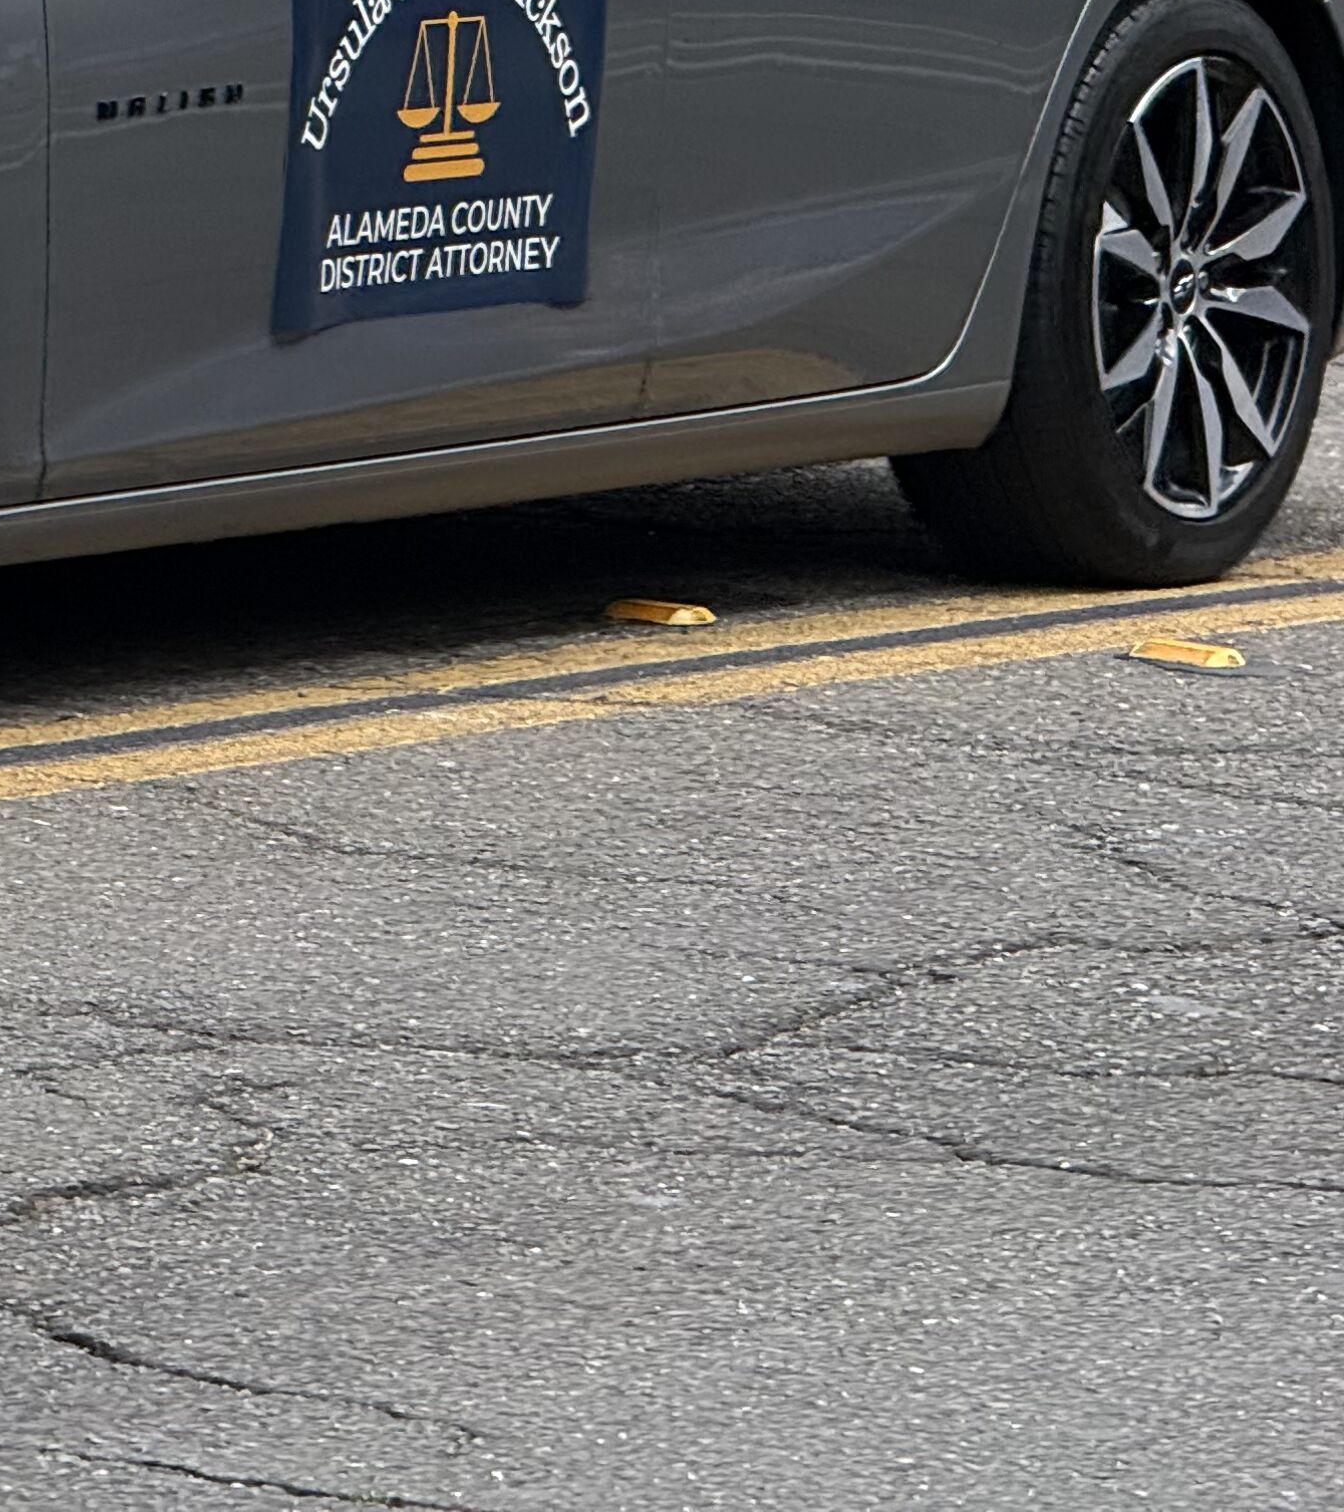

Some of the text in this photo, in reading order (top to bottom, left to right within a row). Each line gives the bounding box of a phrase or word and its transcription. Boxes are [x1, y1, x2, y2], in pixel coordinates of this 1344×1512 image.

[325, 193, 555, 249] ALAMEDA COUNTY
[319, 236, 561, 294] DISTRICT ATTORNEY
